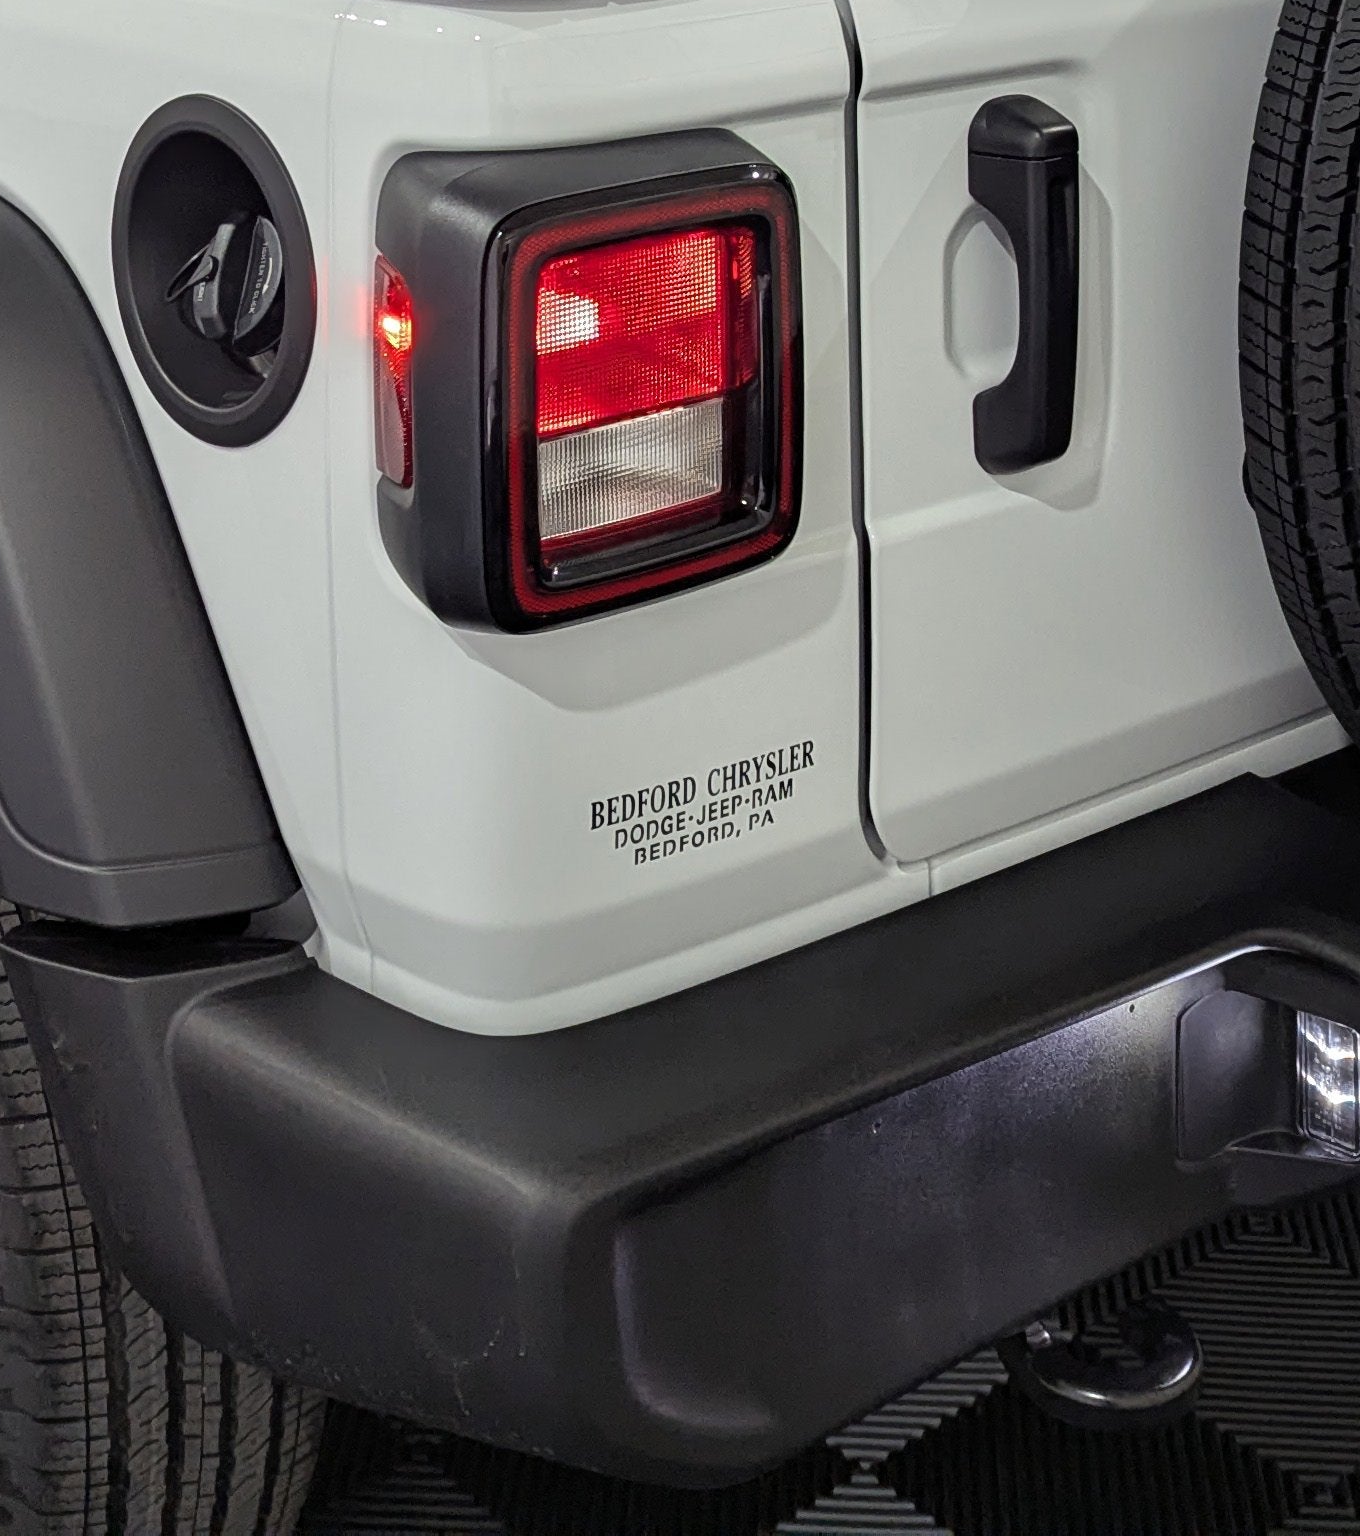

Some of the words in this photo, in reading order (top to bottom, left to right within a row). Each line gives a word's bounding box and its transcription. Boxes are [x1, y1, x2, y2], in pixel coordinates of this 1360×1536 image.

[591, 776, 697, 830] BEDFORD
[707, 740, 814, 797] CHRYSLER
[634, 822, 741, 865] BEDFORD,
[749, 809, 774, 830] PA
